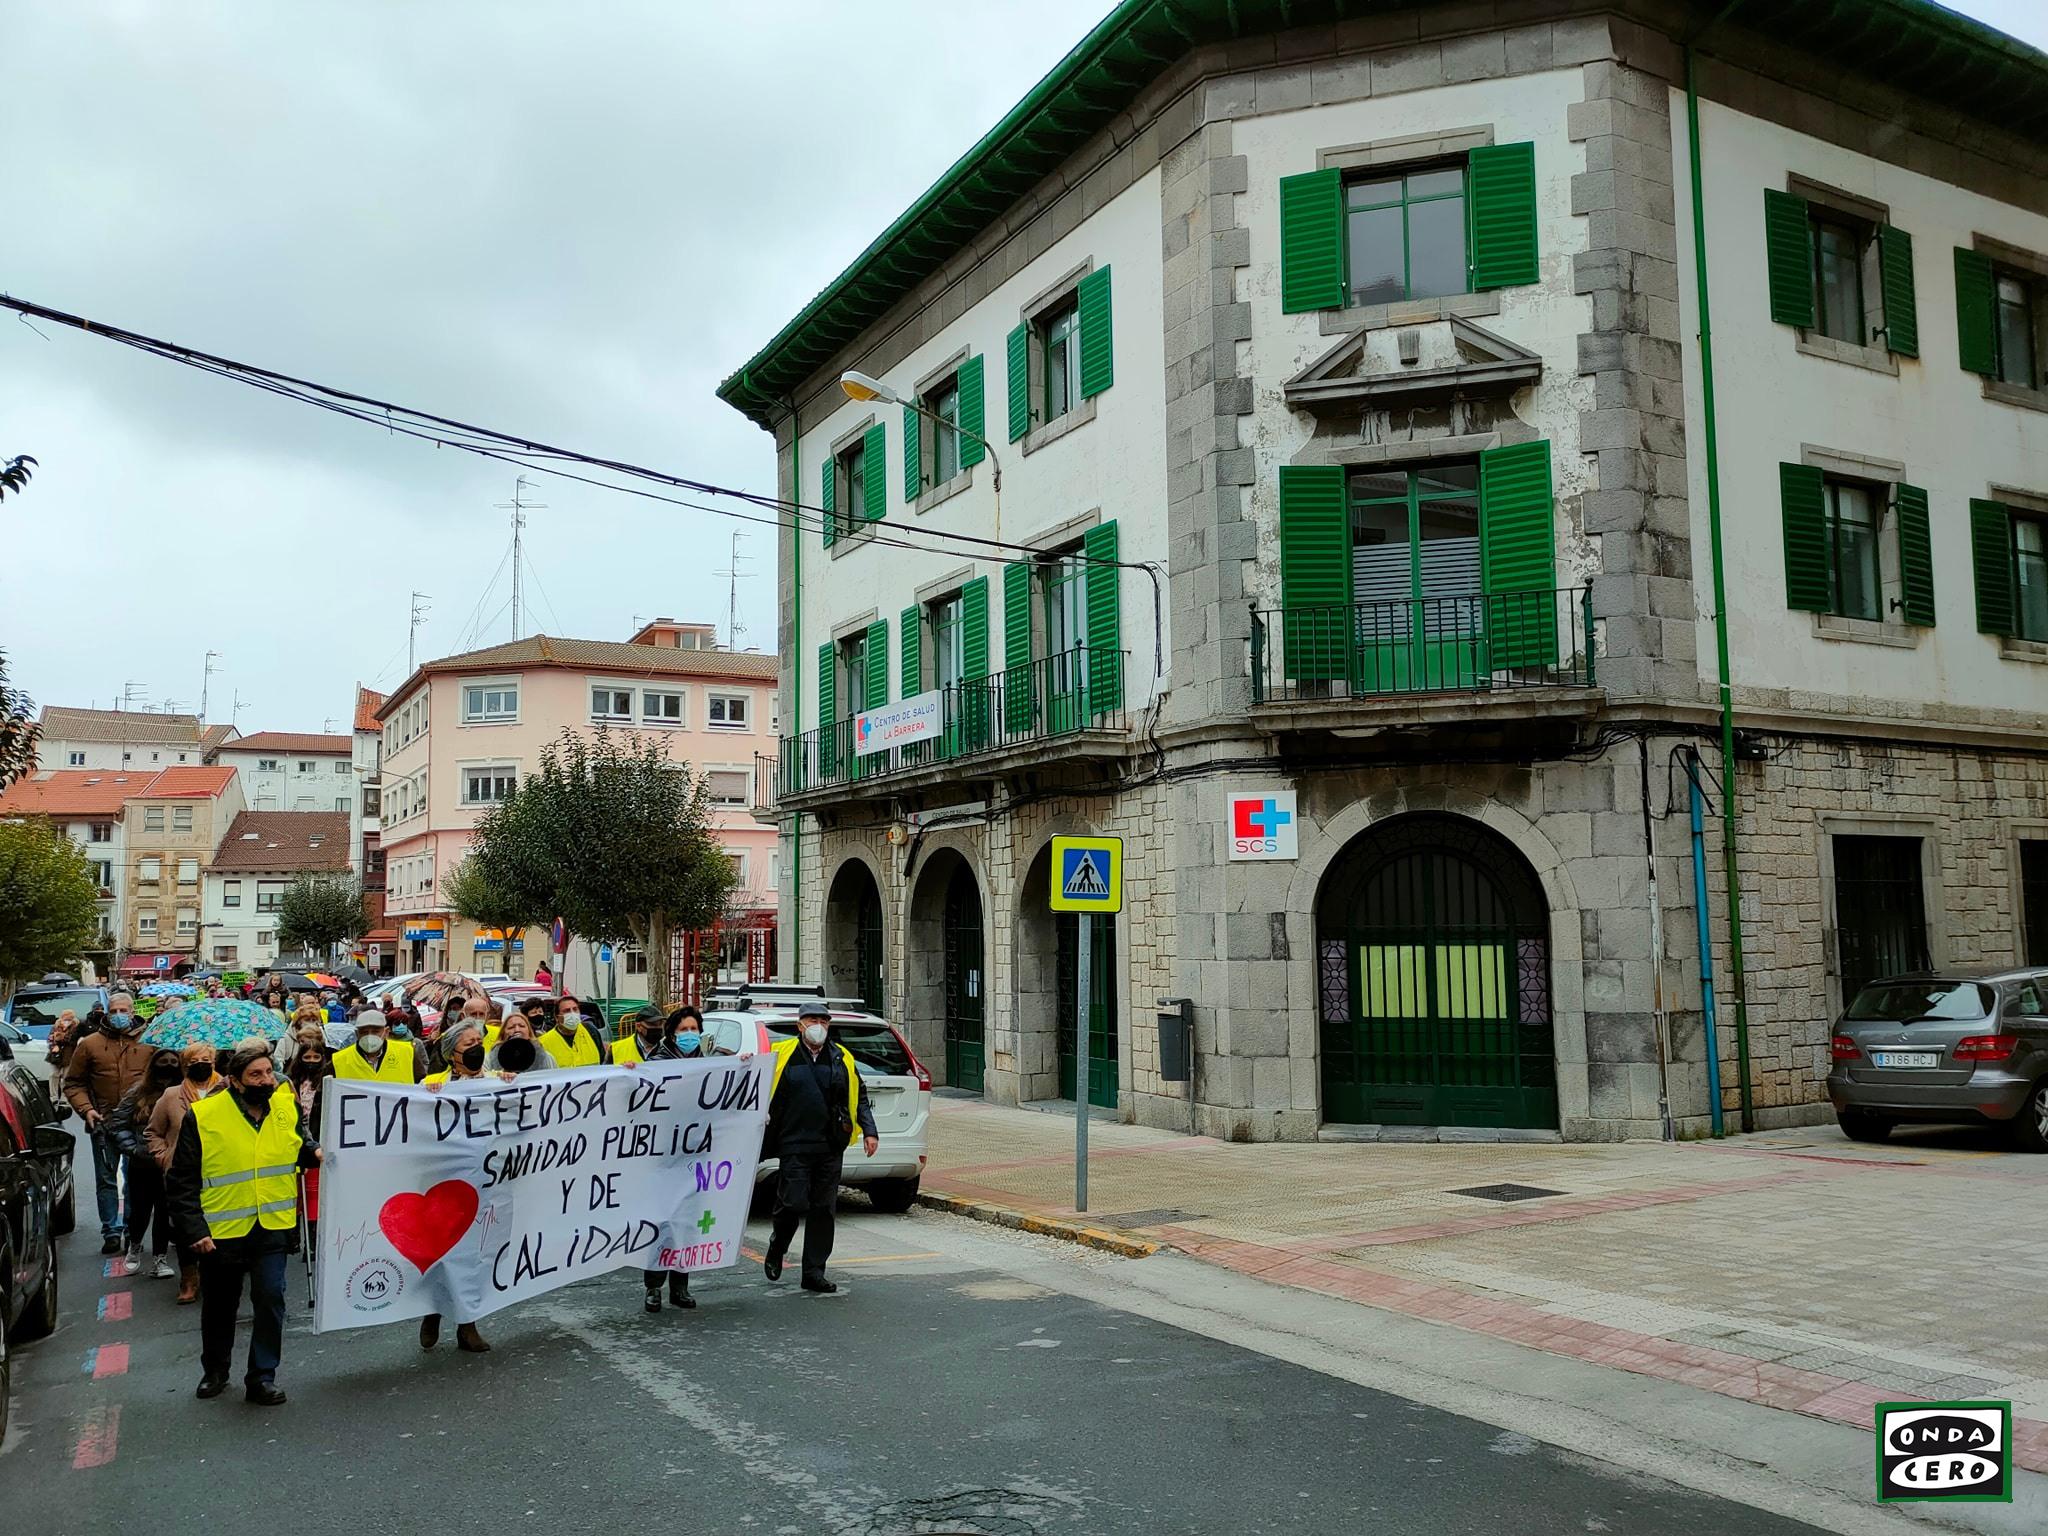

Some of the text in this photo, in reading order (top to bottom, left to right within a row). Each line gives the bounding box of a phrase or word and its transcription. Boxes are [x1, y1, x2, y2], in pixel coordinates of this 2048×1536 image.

[874, 704, 935, 728] CENTRO DE SALUD
[894, 722, 925, 737] BARRERA
[1235, 839, 1278, 854] SCS
[156, 957, 167, 969] P
[1885, 1055, 1934, 1065] 3186 HCJ
[339, 1094, 409, 1149] EN
[434, 1079, 609, 1142] DEFENSA
[627, 1075, 682, 1113] DE
[697, 1068, 762, 1111] UNA
[481, 1119, 713, 1189] SANIDAD PÚBLICA
[561, 1172, 622, 1214] Y DE
[492, 1219, 660, 1292] CALIDAD
